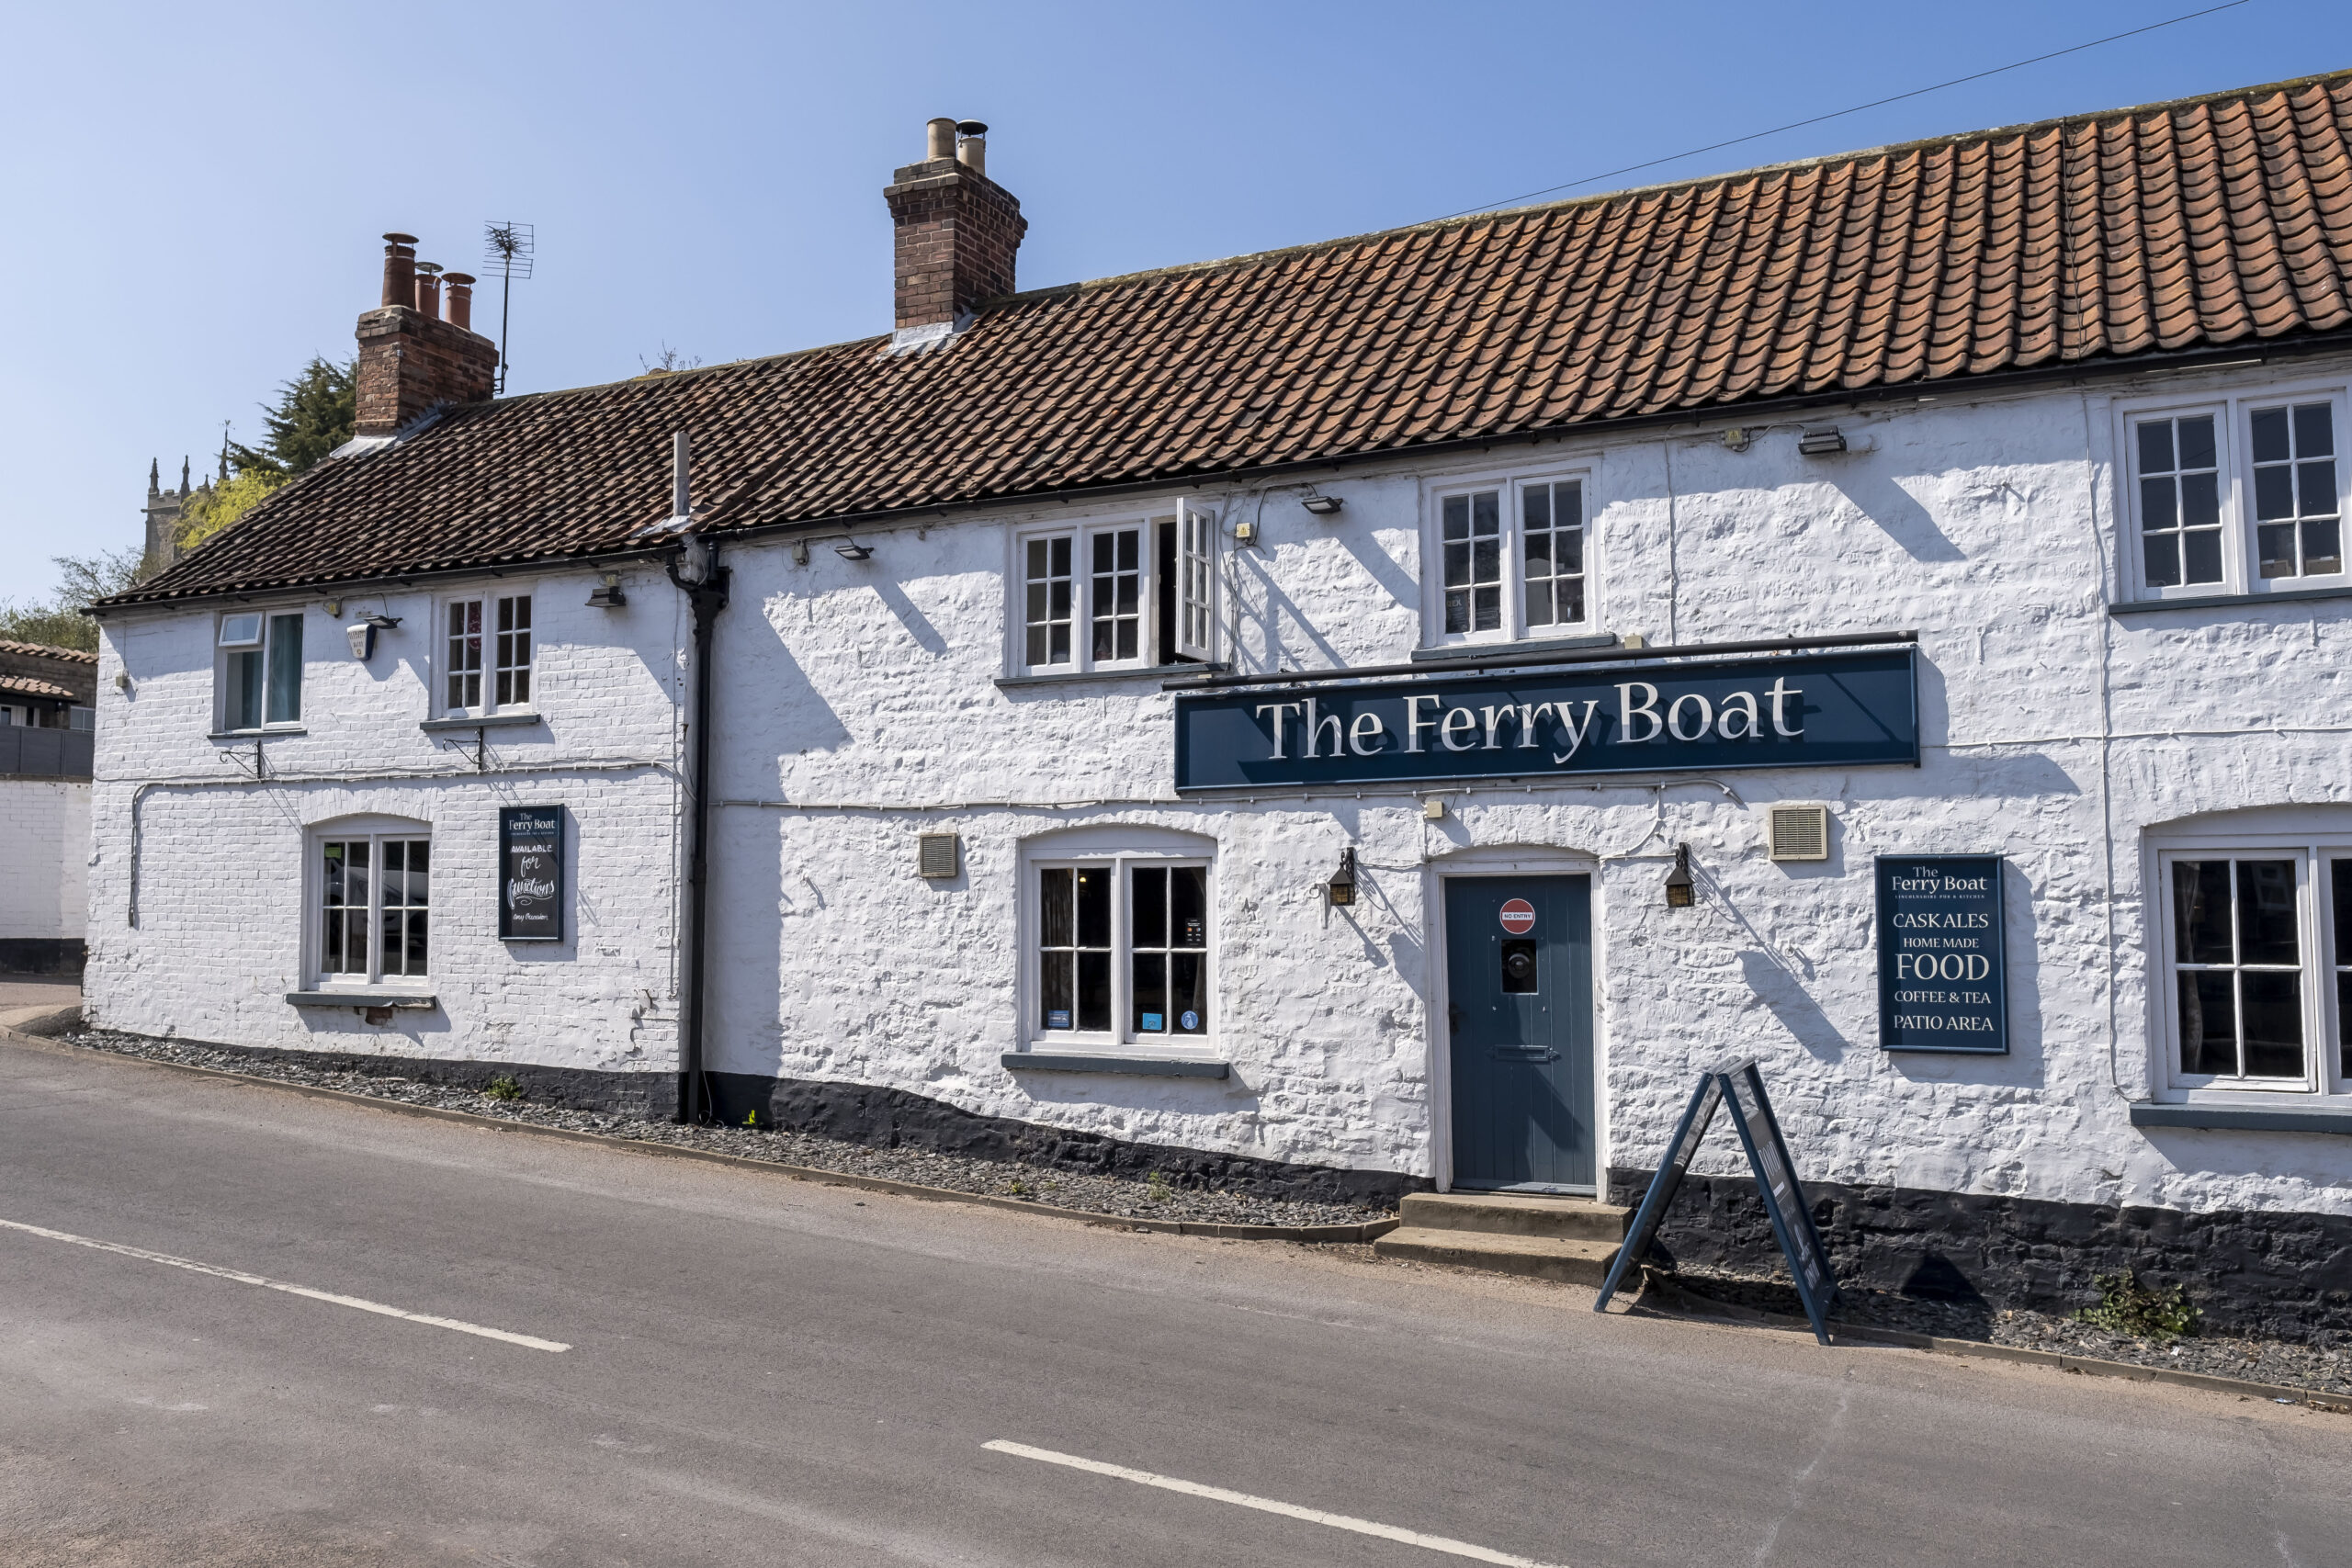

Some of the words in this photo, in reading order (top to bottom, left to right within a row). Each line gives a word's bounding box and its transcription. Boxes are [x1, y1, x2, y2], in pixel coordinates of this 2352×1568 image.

[1256, 697, 1383, 760] The
[1403, 694, 1599, 764] Ferry
[1614, 676, 1805, 744] Boat
[519, 813, 532, 821] The
[509, 819, 533, 832] Ferry
[534, 818, 556, 829] Boat
[511, 844, 553, 853] AVAILABLE
[520, 855, 541, 877] for
[1913, 865, 1939, 878] The
[1892, 875, 1940, 894] Ferry
[1944, 875, 1988, 891] Boat
[1894, 913, 1941, 928] CASK
[1943, 913, 1989, 929] ALES
[1904, 937, 1940, 948] HOME
[1942, 937, 1979, 949] MADE
[1895, 953, 1990, 981] FOOD
[1894, 990, 1946, 1003] COFFEE
[1949, 991, 1960, 1003] &
[1962, 991, 1992, 1004] TEA
[1894, 1015, 1943, 1030] PATIO
[1946, 1016, 1995, 1032] AREA
